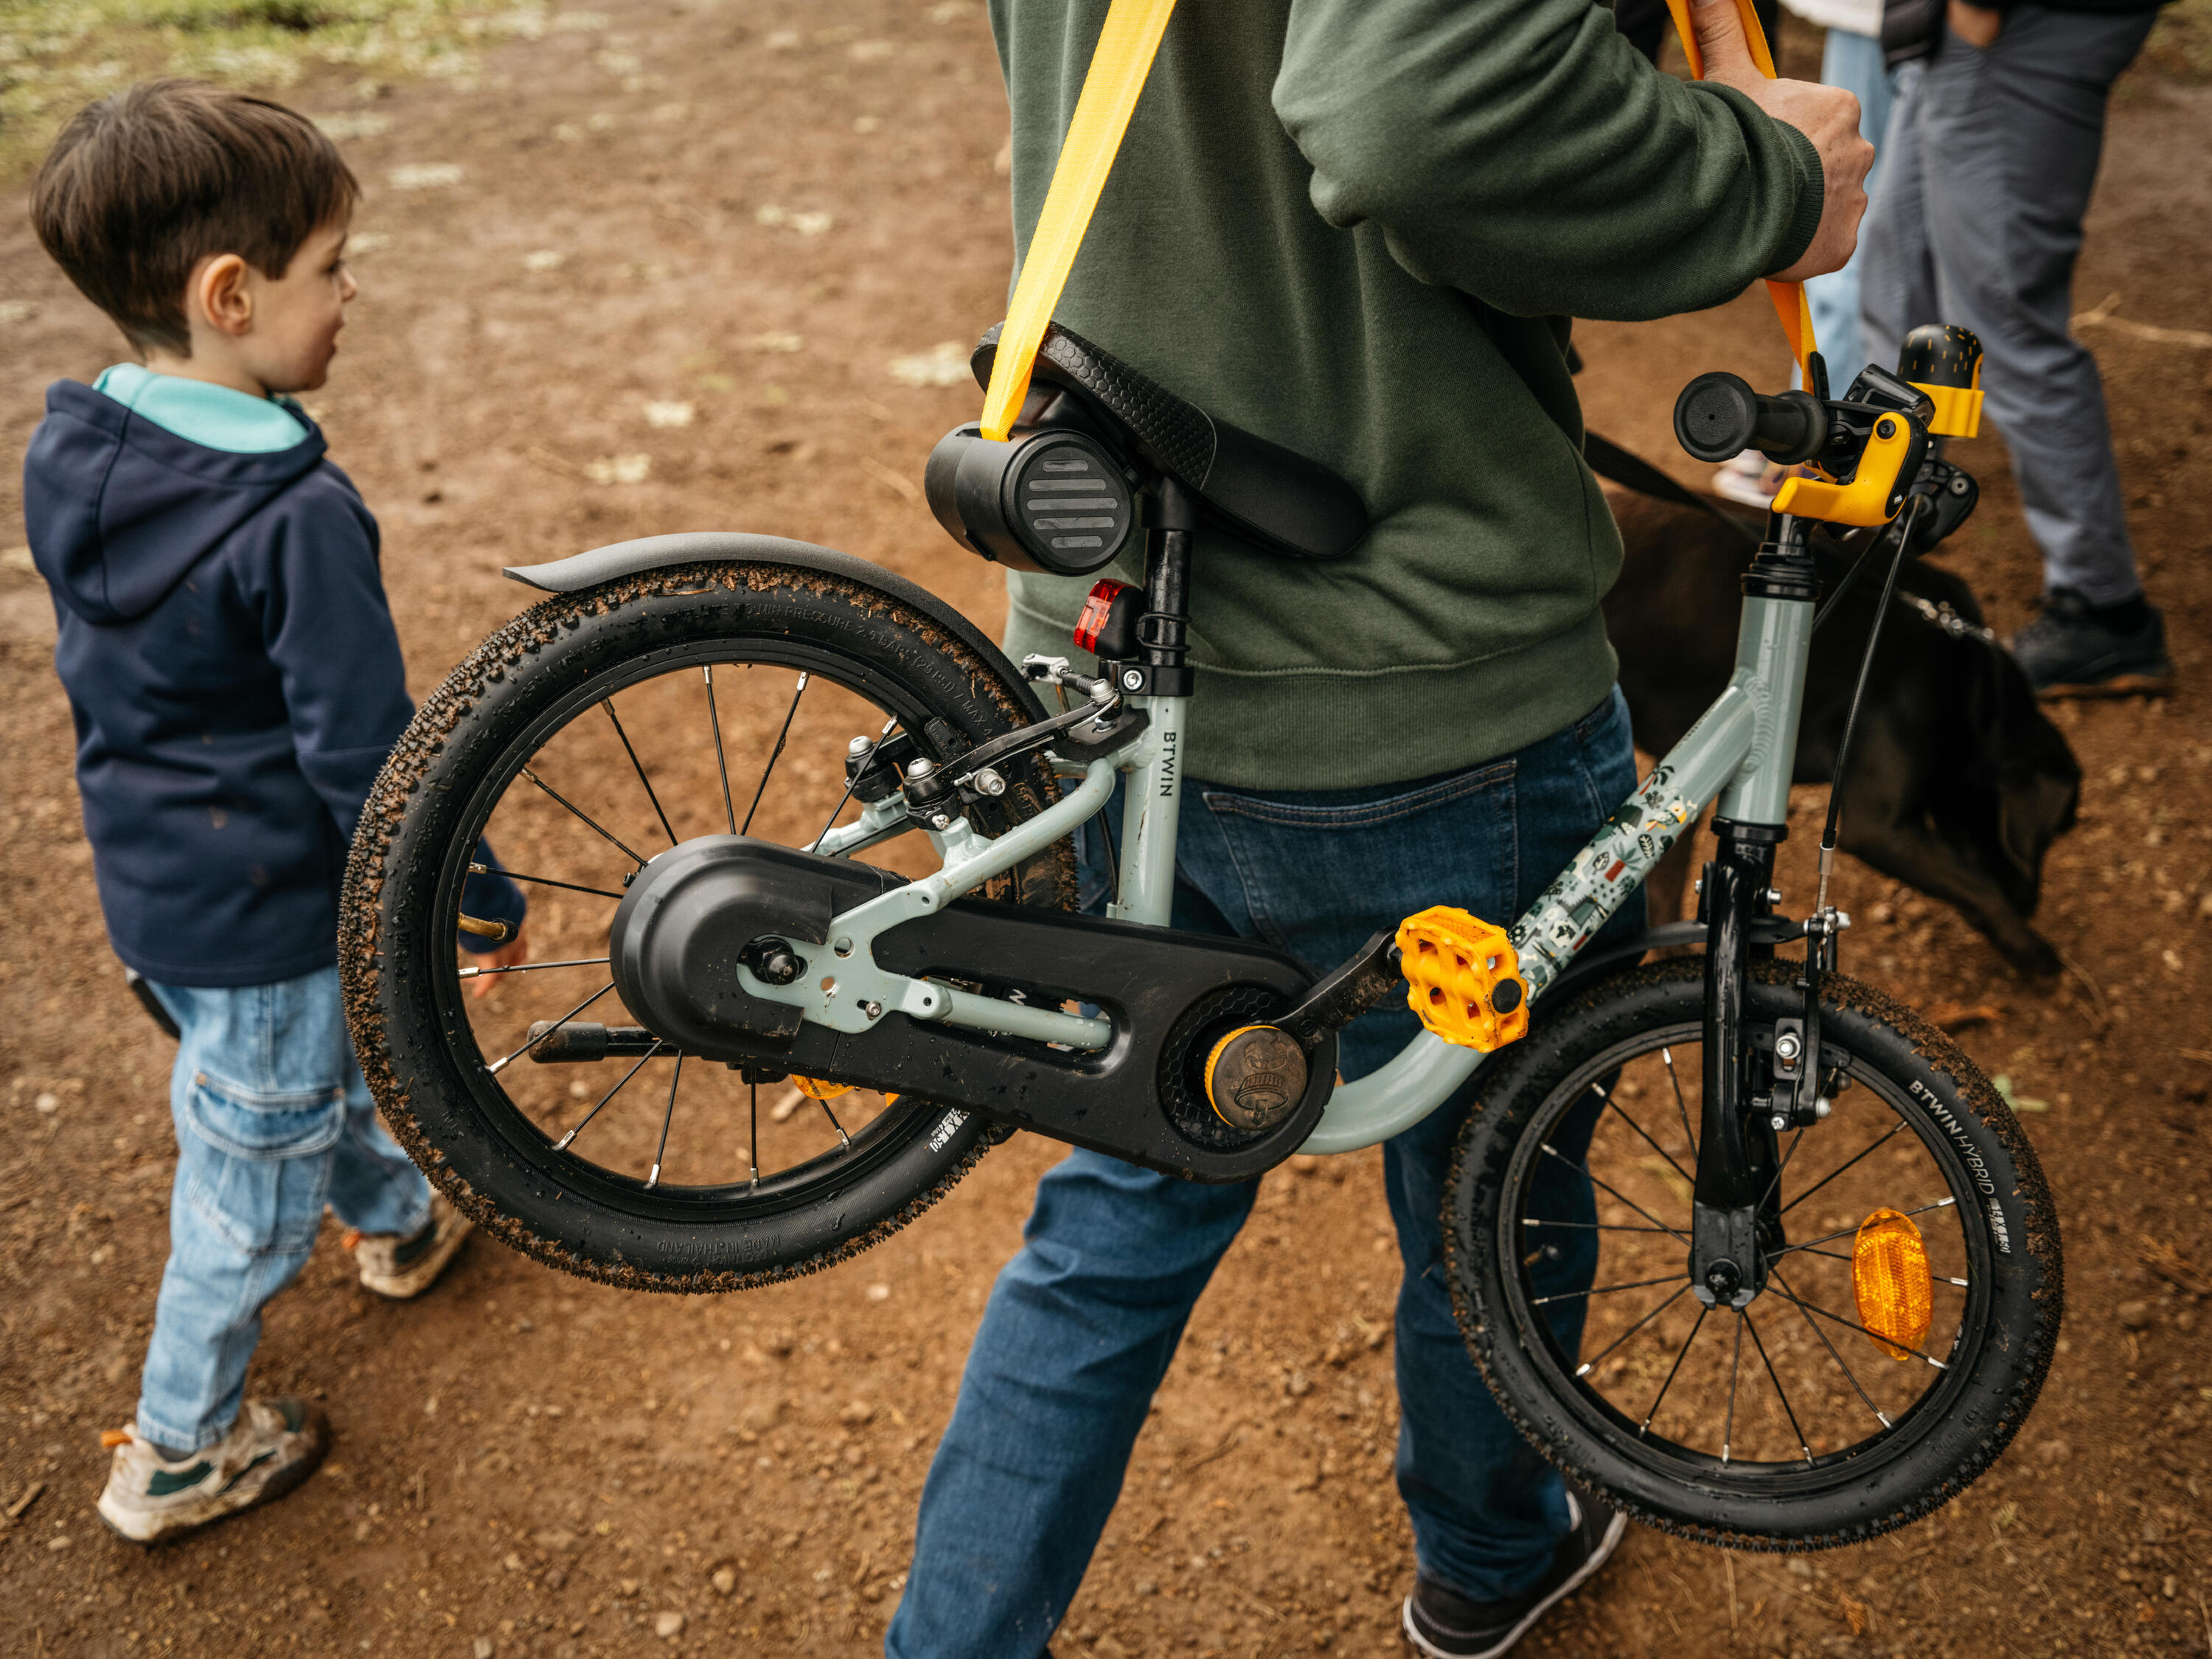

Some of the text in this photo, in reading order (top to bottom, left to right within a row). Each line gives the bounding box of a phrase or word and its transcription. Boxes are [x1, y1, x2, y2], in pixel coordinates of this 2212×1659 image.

[961, 700, 987, 727] MAX
[1953, 1135, 1995, 1195] HYBRID
[656, 1234, 781, 1255] MADE IN THAILAND
